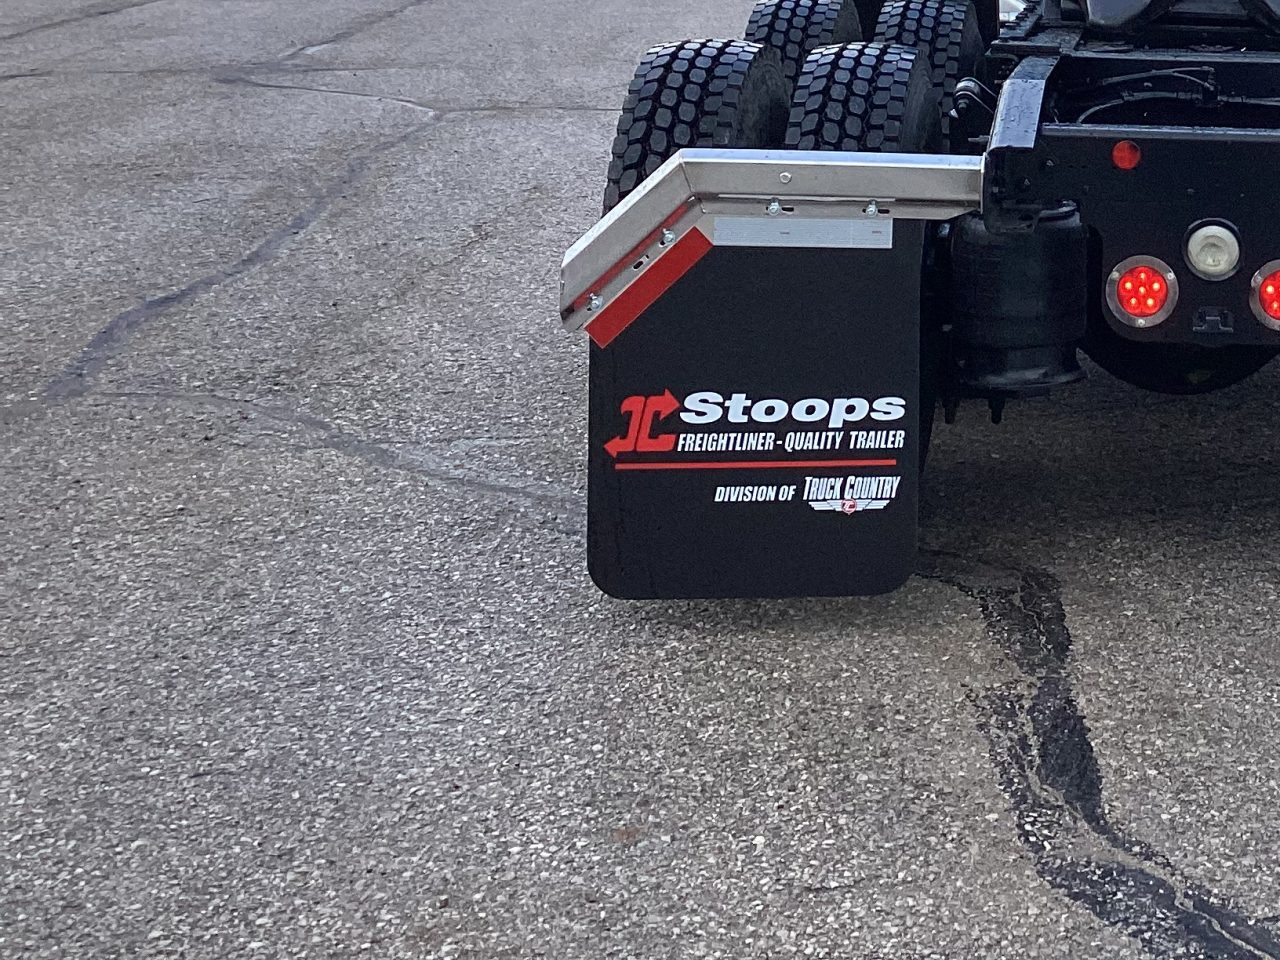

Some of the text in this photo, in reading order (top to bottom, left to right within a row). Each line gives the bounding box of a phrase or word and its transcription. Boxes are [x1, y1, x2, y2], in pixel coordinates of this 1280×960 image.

[680, 391, 906, 428] Stoops
[849, 430, 905, 449] TRAILER
[714, 475, 901, 502] DIVISION OF TRUCK COUNTRY
